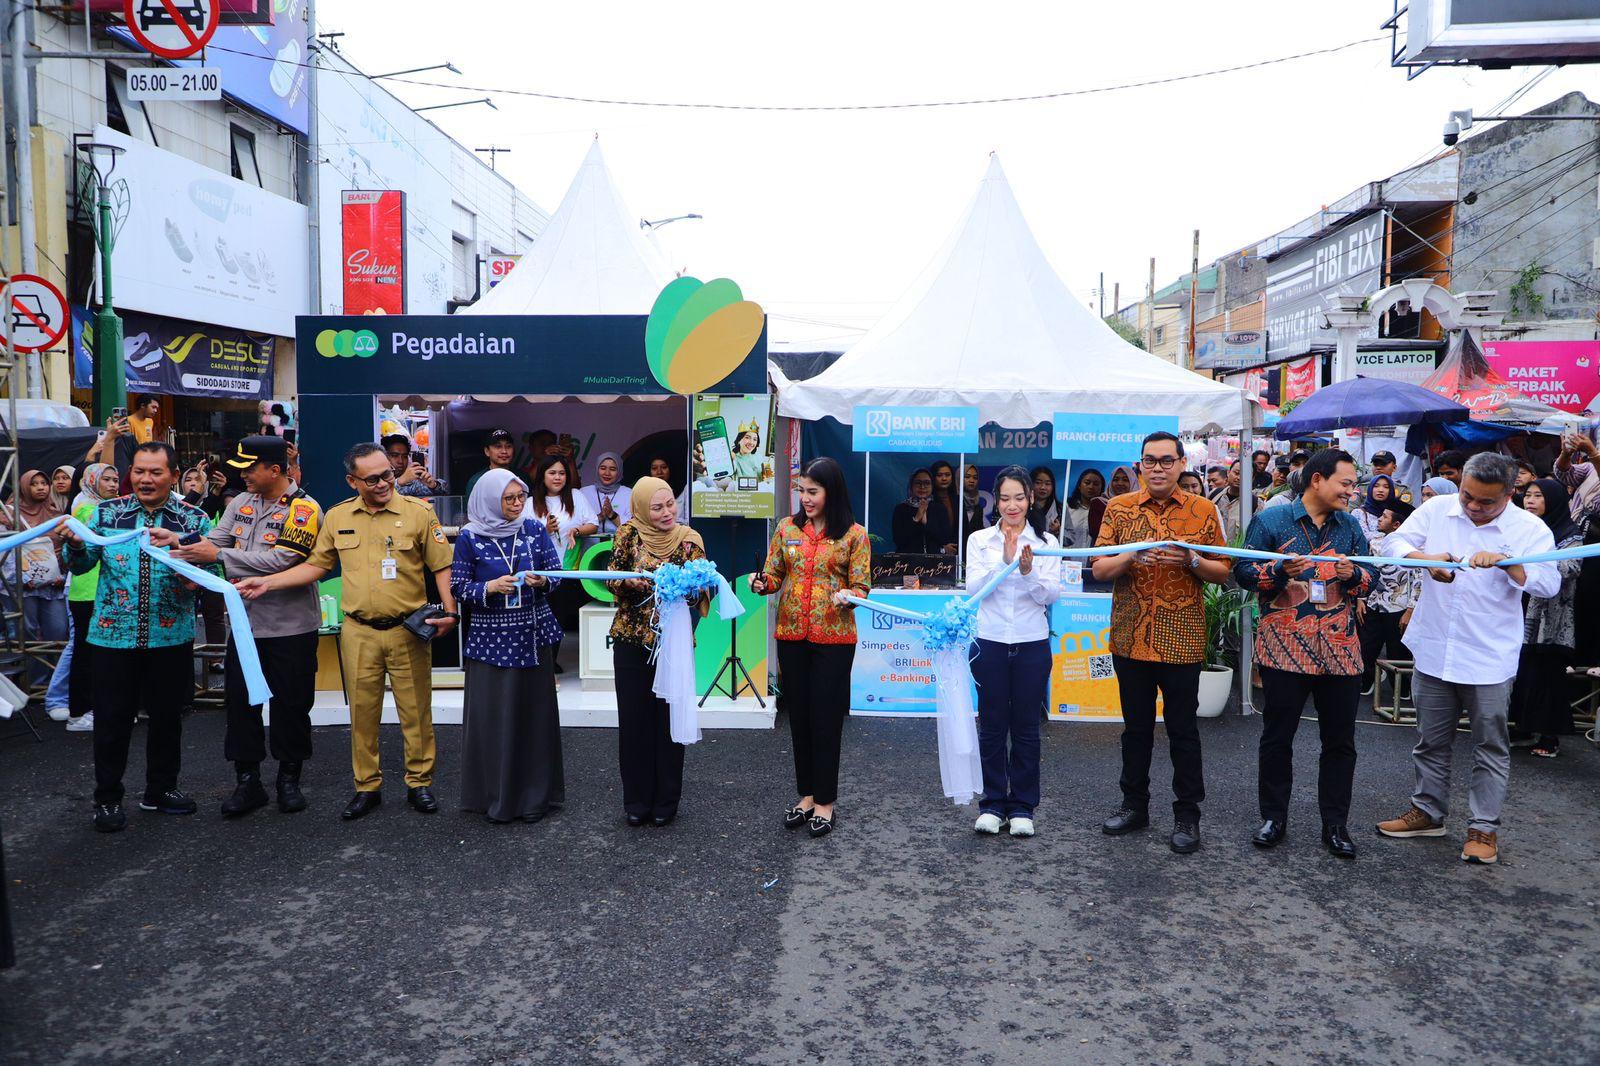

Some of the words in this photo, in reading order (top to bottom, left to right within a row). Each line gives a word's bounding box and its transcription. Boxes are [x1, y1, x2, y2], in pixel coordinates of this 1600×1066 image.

[131, 74, 168, 92] 05.00
[182, 73, 218, 91] 21.00
[347, 249, 397, 274] Sukun
[376, 276, 397, 284] NEW
[1269, 309, 1304, 343] SERVICE
[391, 332, 515, 360] Pegadaian
[1386, 354, 1433, 364] LAPTOP
[210, 362, 230, 371] CASUAL
[1508, 367, 1558, 378] PAKET
[196, 377, 230, 388] SIDODADI
[230, 380, 250, 390] STORE
[1520, 393, 1581, 405] ASNYA
[892, 416, 936, 431] BANK
[940, 417, 965, 431] BRI
[1003, 431, 1049, 448] 2026
[1055, 431, 1096, 441] BRANCH
[1098, 432, 1133, 443] OFFICE
[1071, 613, 1105, 623] BRANCH
[861, 640, 910, 651] Simpedes
